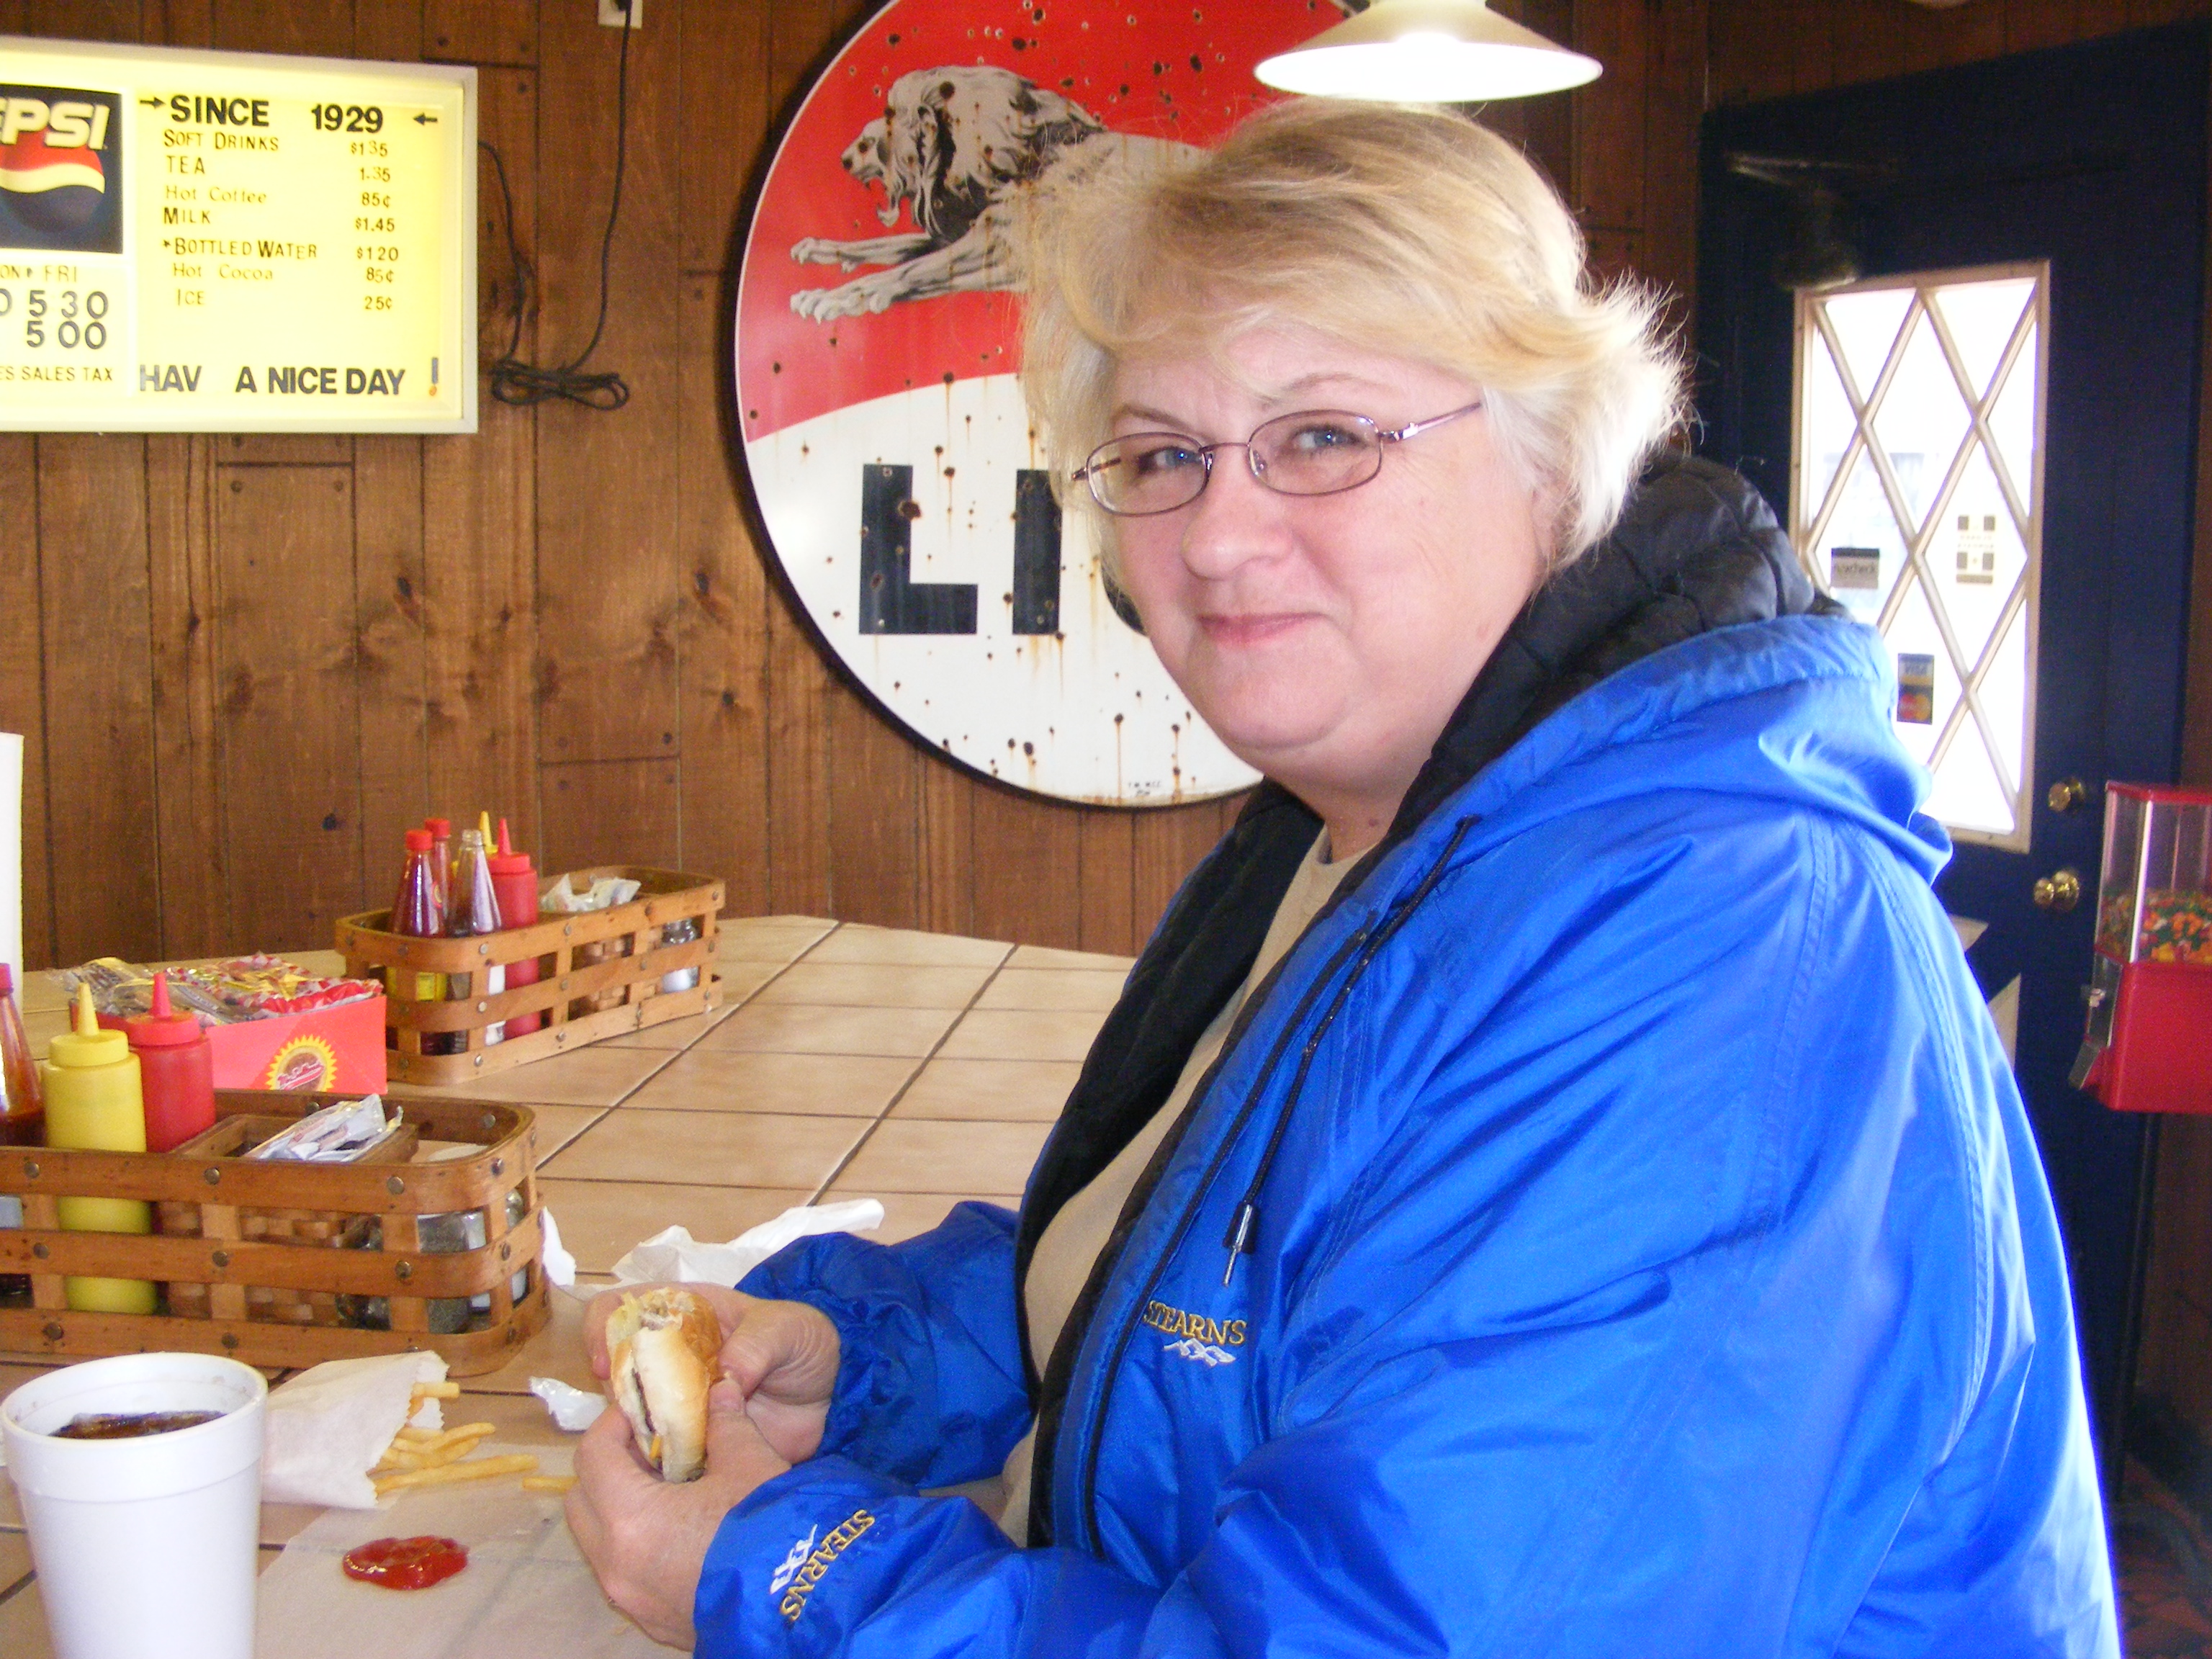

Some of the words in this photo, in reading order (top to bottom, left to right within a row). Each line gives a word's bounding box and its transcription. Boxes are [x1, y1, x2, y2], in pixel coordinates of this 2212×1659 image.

[0, 96, 110, 150] PSI
[171, 94, 269, 127] SINCE
[311, 104, 383, 133] 1929
[164, 129, 203, 148] SOFT
[215, 132, 279, 151] DRINKS
[166, 155, 205, 174] TEA
[166, 185, 197, 201] Hot
[163, 207, 211, 225] MILK
[175, 237, 252, 256] BOTTLED
[258, 240, 318, 259] WATER
[45, 265, 77, 282] FRI
[173, 262, 202, 277] Hot
[219, 264, 274, 280] Cocoa
[177, 288, 204, 306] ICE
[22, 366, 76, 381] SALES
[84, 367, 113, 381] TAX
[140, 364, 202, 392] HAV
[235, 366, 258, 393] A
[269, 366, 337, 395] NICE
[346, 368, 405, 395] DAY
[859, 463, 1148, 637] LI
[1143, 1300, 1248, 1345] STEARNS
[780, 1509, 876, 1622] STEARNS
